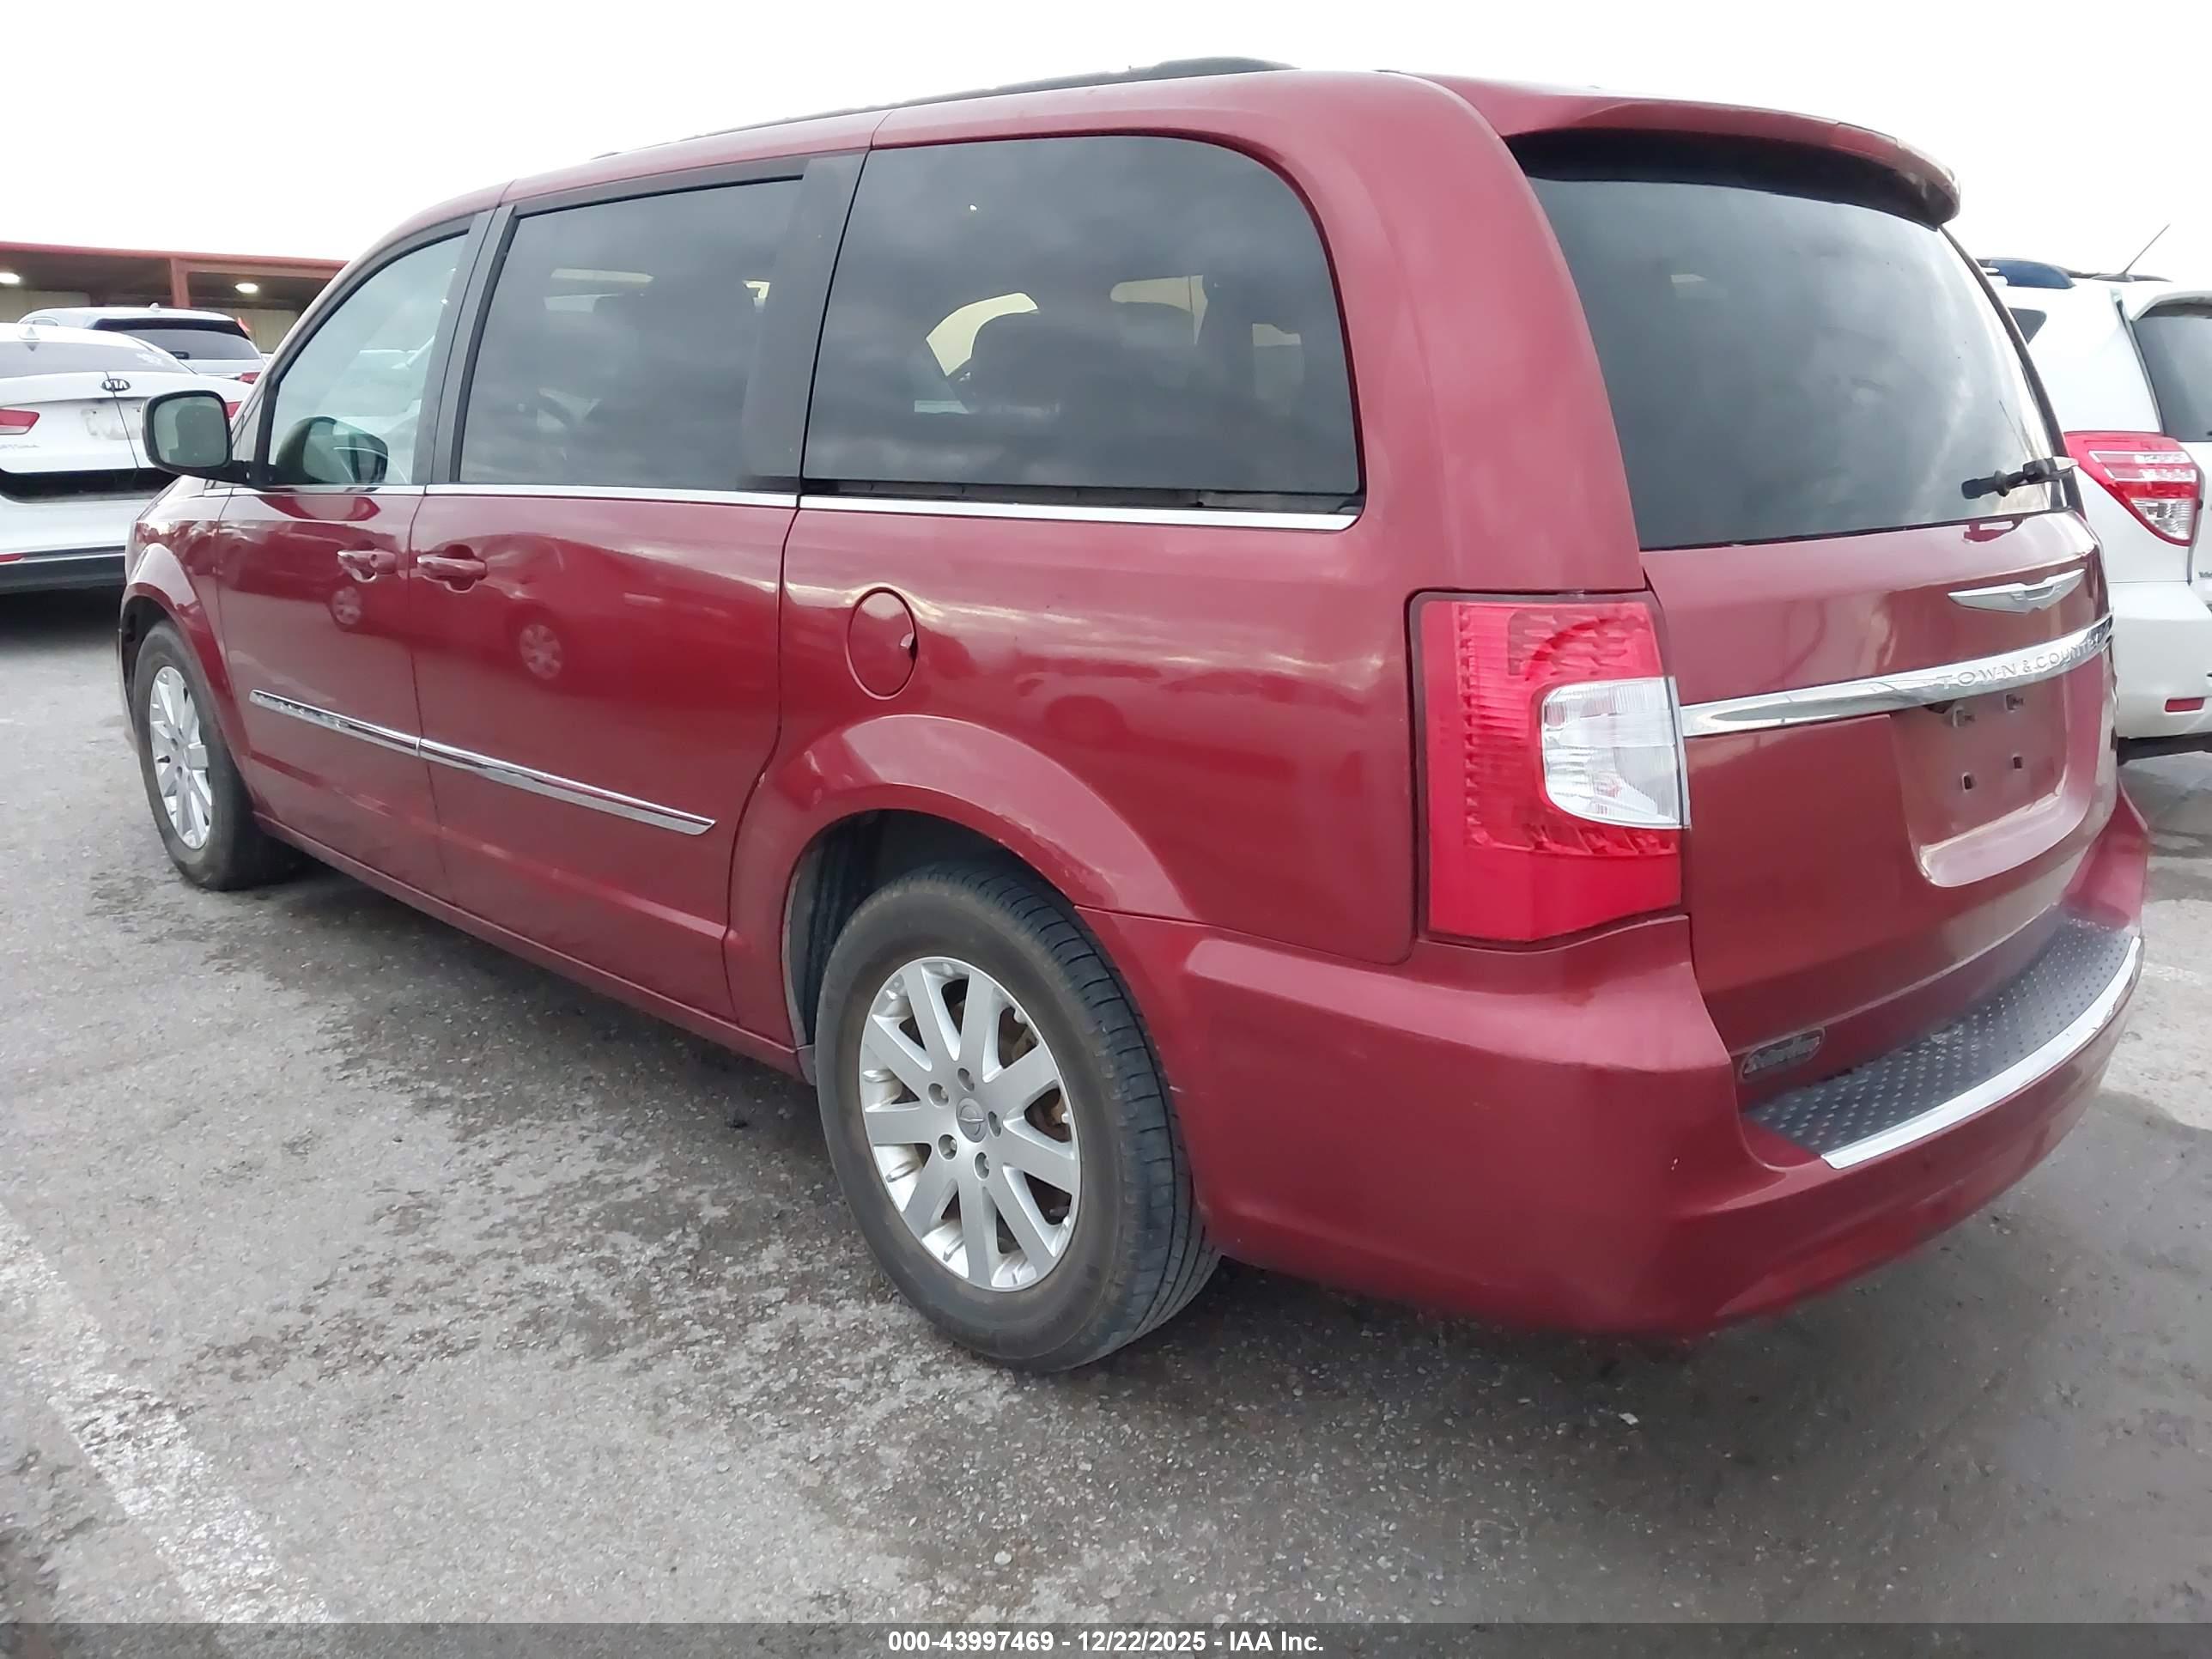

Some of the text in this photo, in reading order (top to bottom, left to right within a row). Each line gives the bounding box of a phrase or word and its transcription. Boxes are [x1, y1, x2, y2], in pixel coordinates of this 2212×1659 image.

[104, 380, 129, 390] KIA
[1937, 633, 2100, 690] TOWN & COUNTRY
